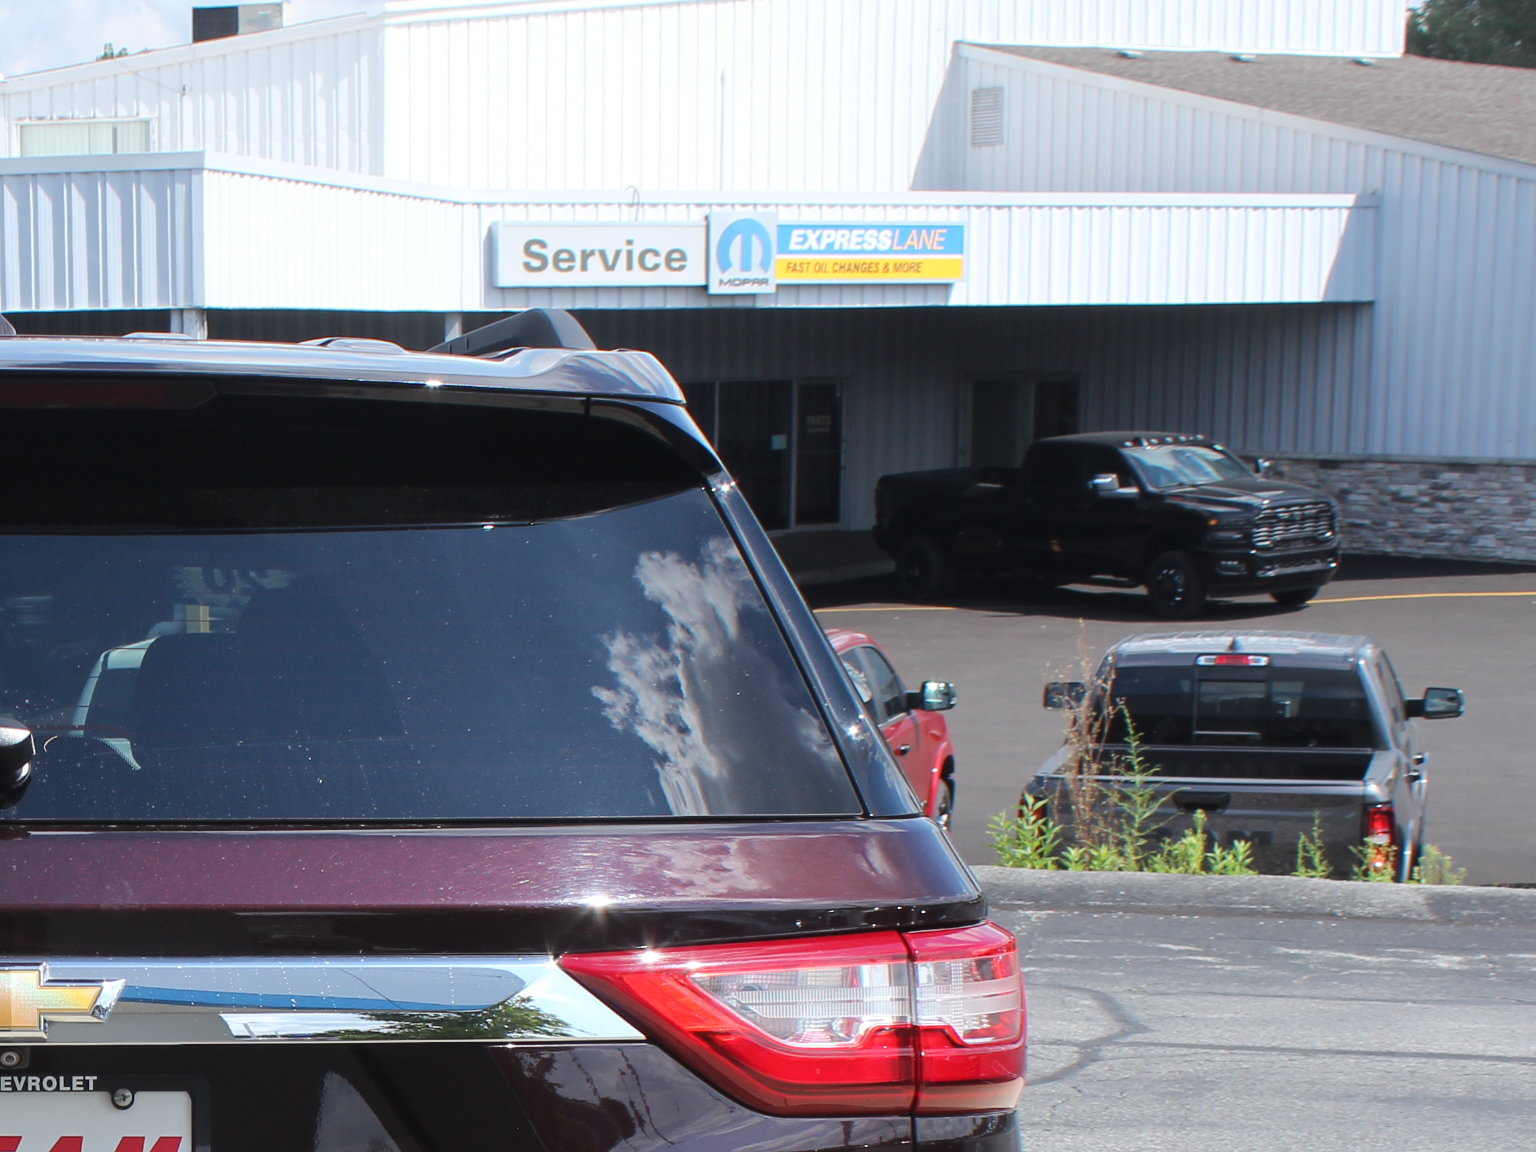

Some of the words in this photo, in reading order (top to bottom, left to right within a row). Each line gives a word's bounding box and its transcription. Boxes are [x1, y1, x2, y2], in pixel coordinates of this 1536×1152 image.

[522, 238, 688, 273] Service
[785, 262, 811, 273] FAST
[814, 262, 830, 273] OIL
[832, 262, 880, 273] CHANGES
[882, 262, 890, 273] &
[892, 262, 923, 273] MORE
[718, 277, 770, 287] MOPAR
